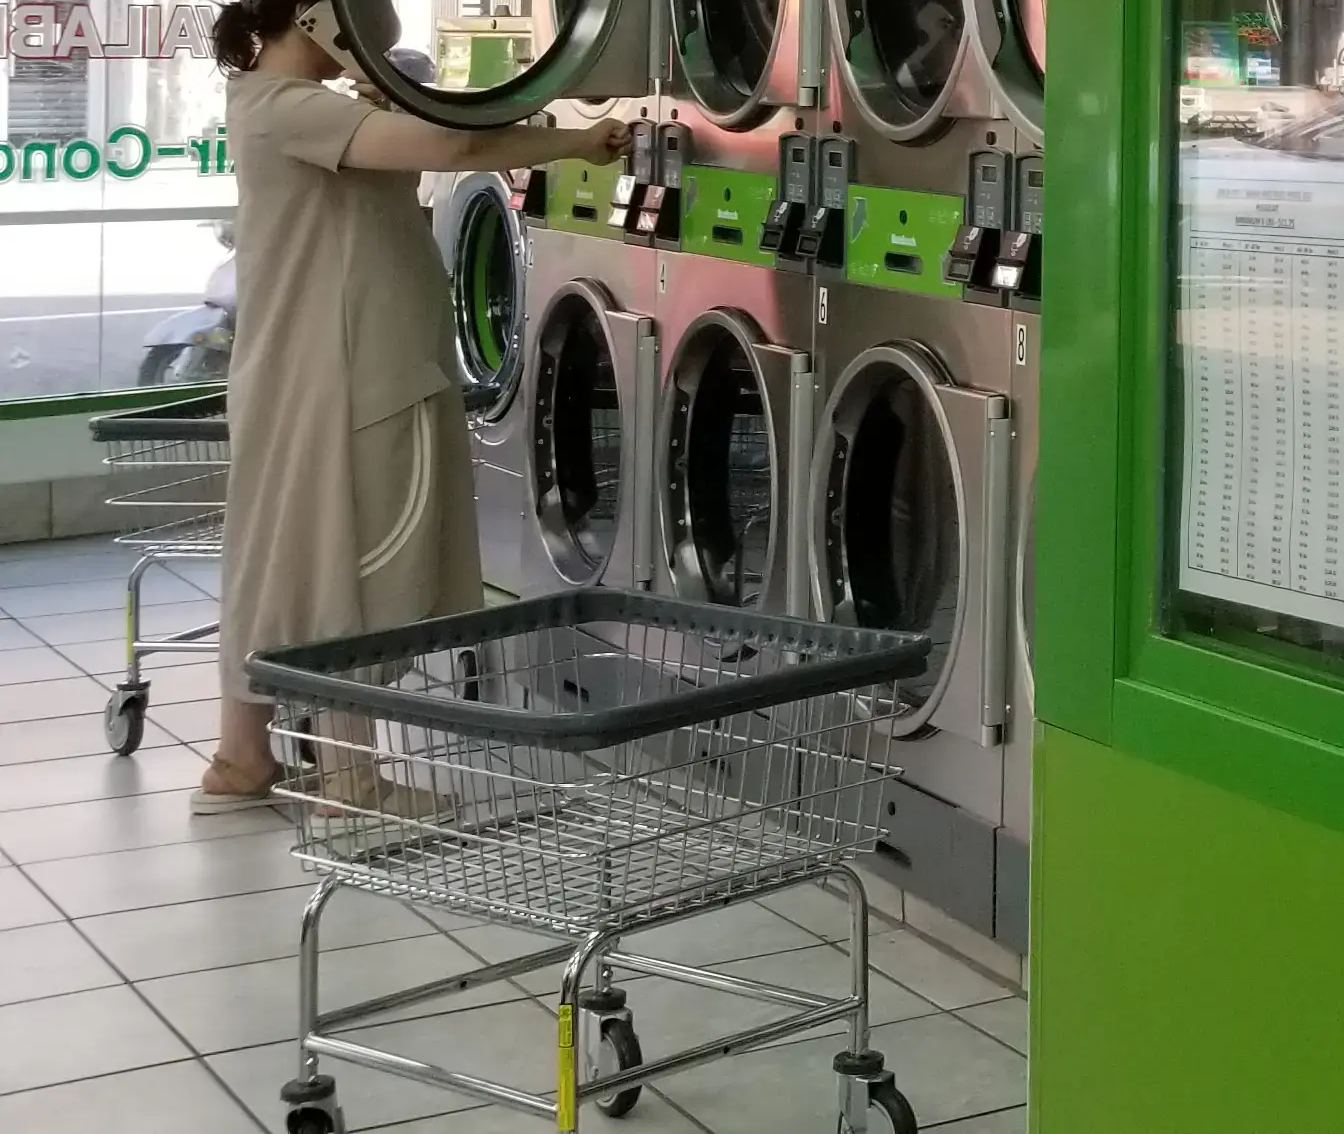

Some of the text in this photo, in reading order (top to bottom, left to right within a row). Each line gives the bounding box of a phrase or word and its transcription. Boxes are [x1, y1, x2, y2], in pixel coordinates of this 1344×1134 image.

[660, 264, 665, 290] 4
[819, 295, 826, 317] 6
[1017, 328, 1025, 362] 8
